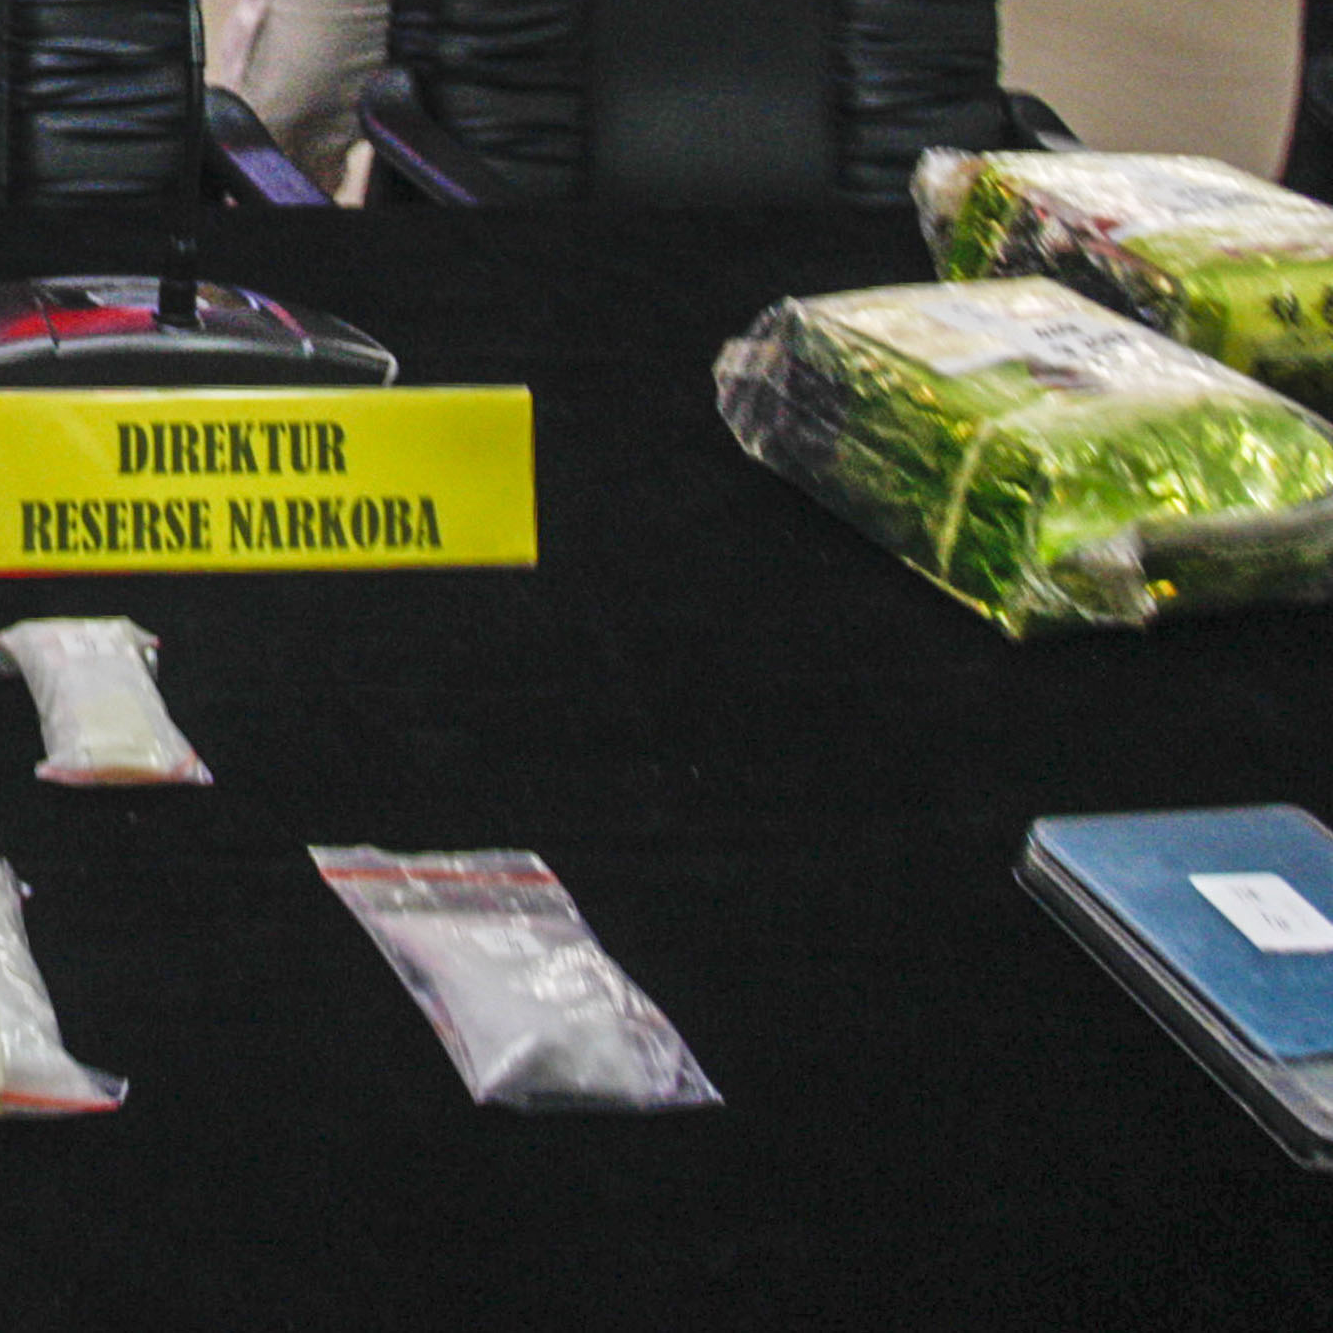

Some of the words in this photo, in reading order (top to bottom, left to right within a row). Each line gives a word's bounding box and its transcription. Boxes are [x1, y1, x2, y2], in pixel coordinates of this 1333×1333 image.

[116, 422, 348, 476] DIREKTUR
[21, 498, 213, 555] RESERSE
[228, 495, 443, 554] NARKOBA
